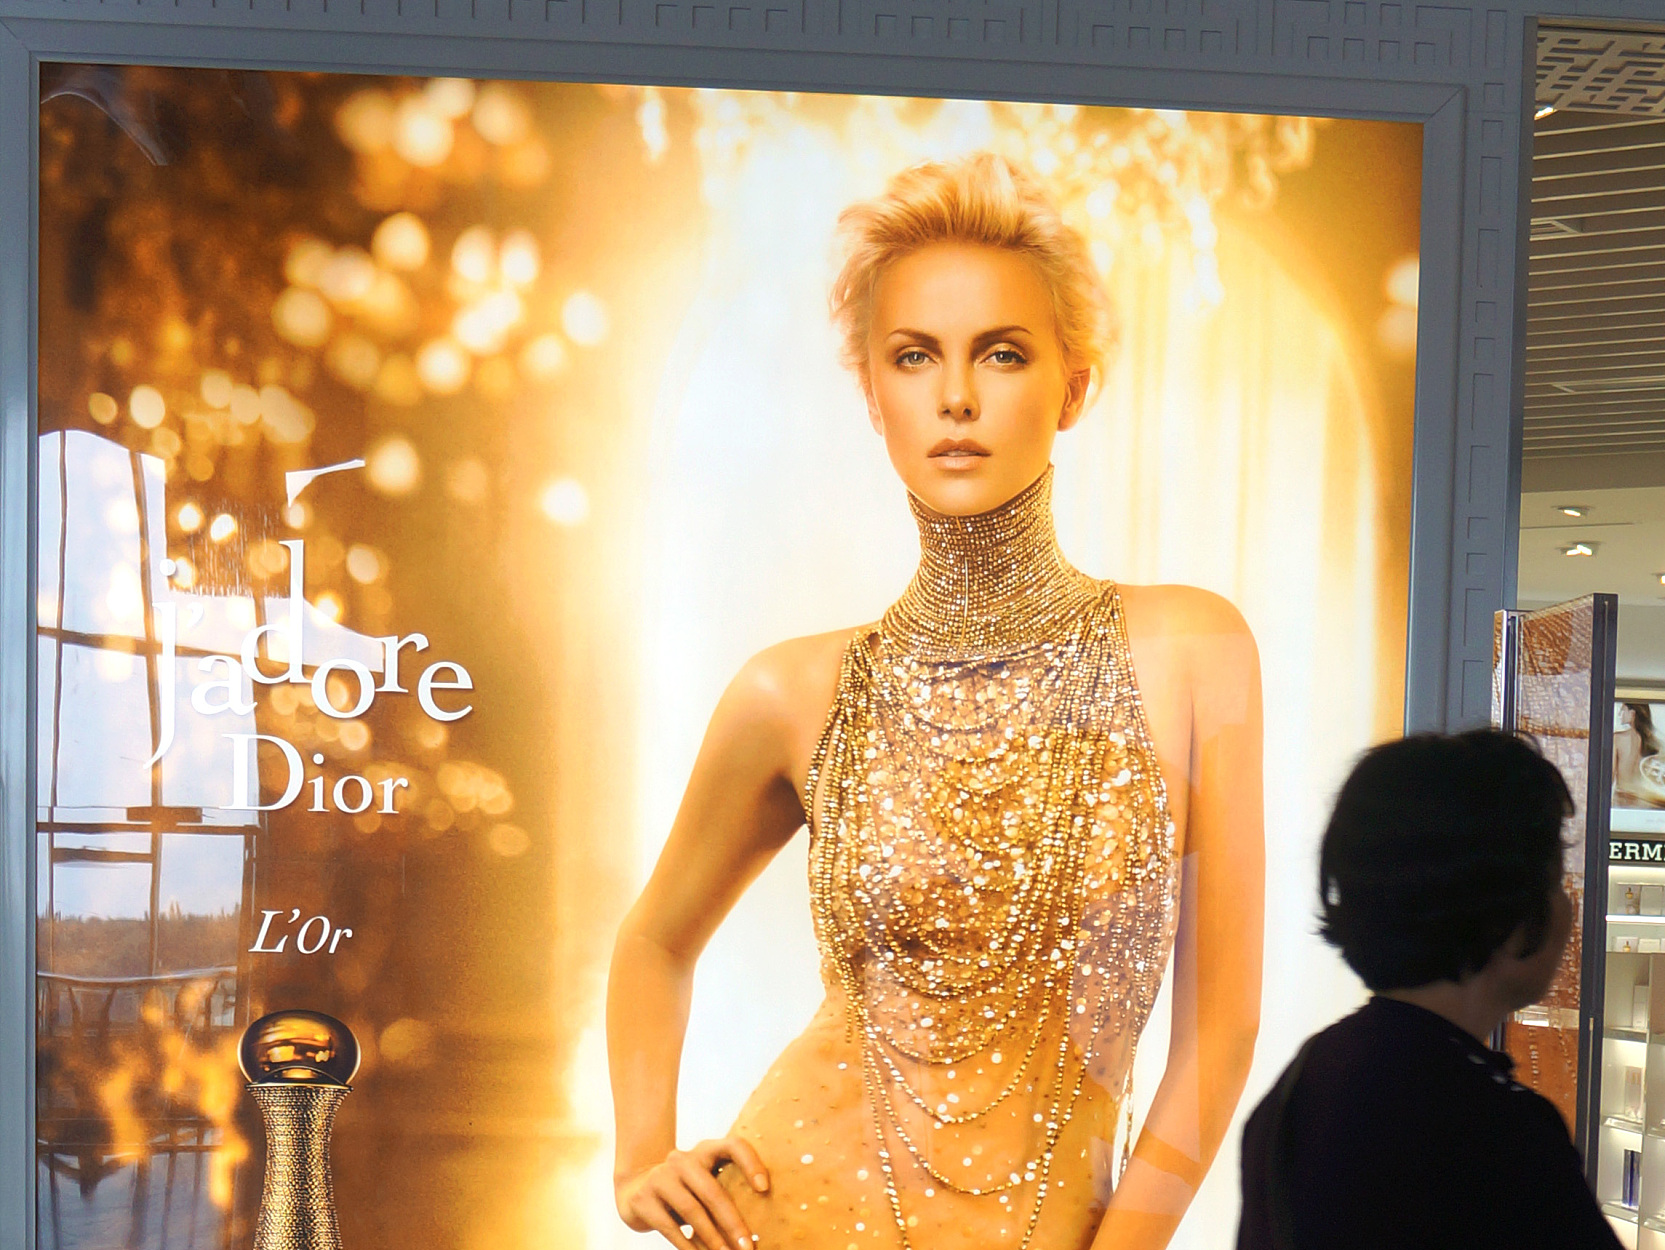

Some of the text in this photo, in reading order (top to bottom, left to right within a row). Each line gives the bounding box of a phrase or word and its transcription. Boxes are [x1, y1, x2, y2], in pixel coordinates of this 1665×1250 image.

[218, 733, 409, 815] Dior
[1608, 841, 1665, 862] ERM
[247, 908, 354, 955] L'Or
